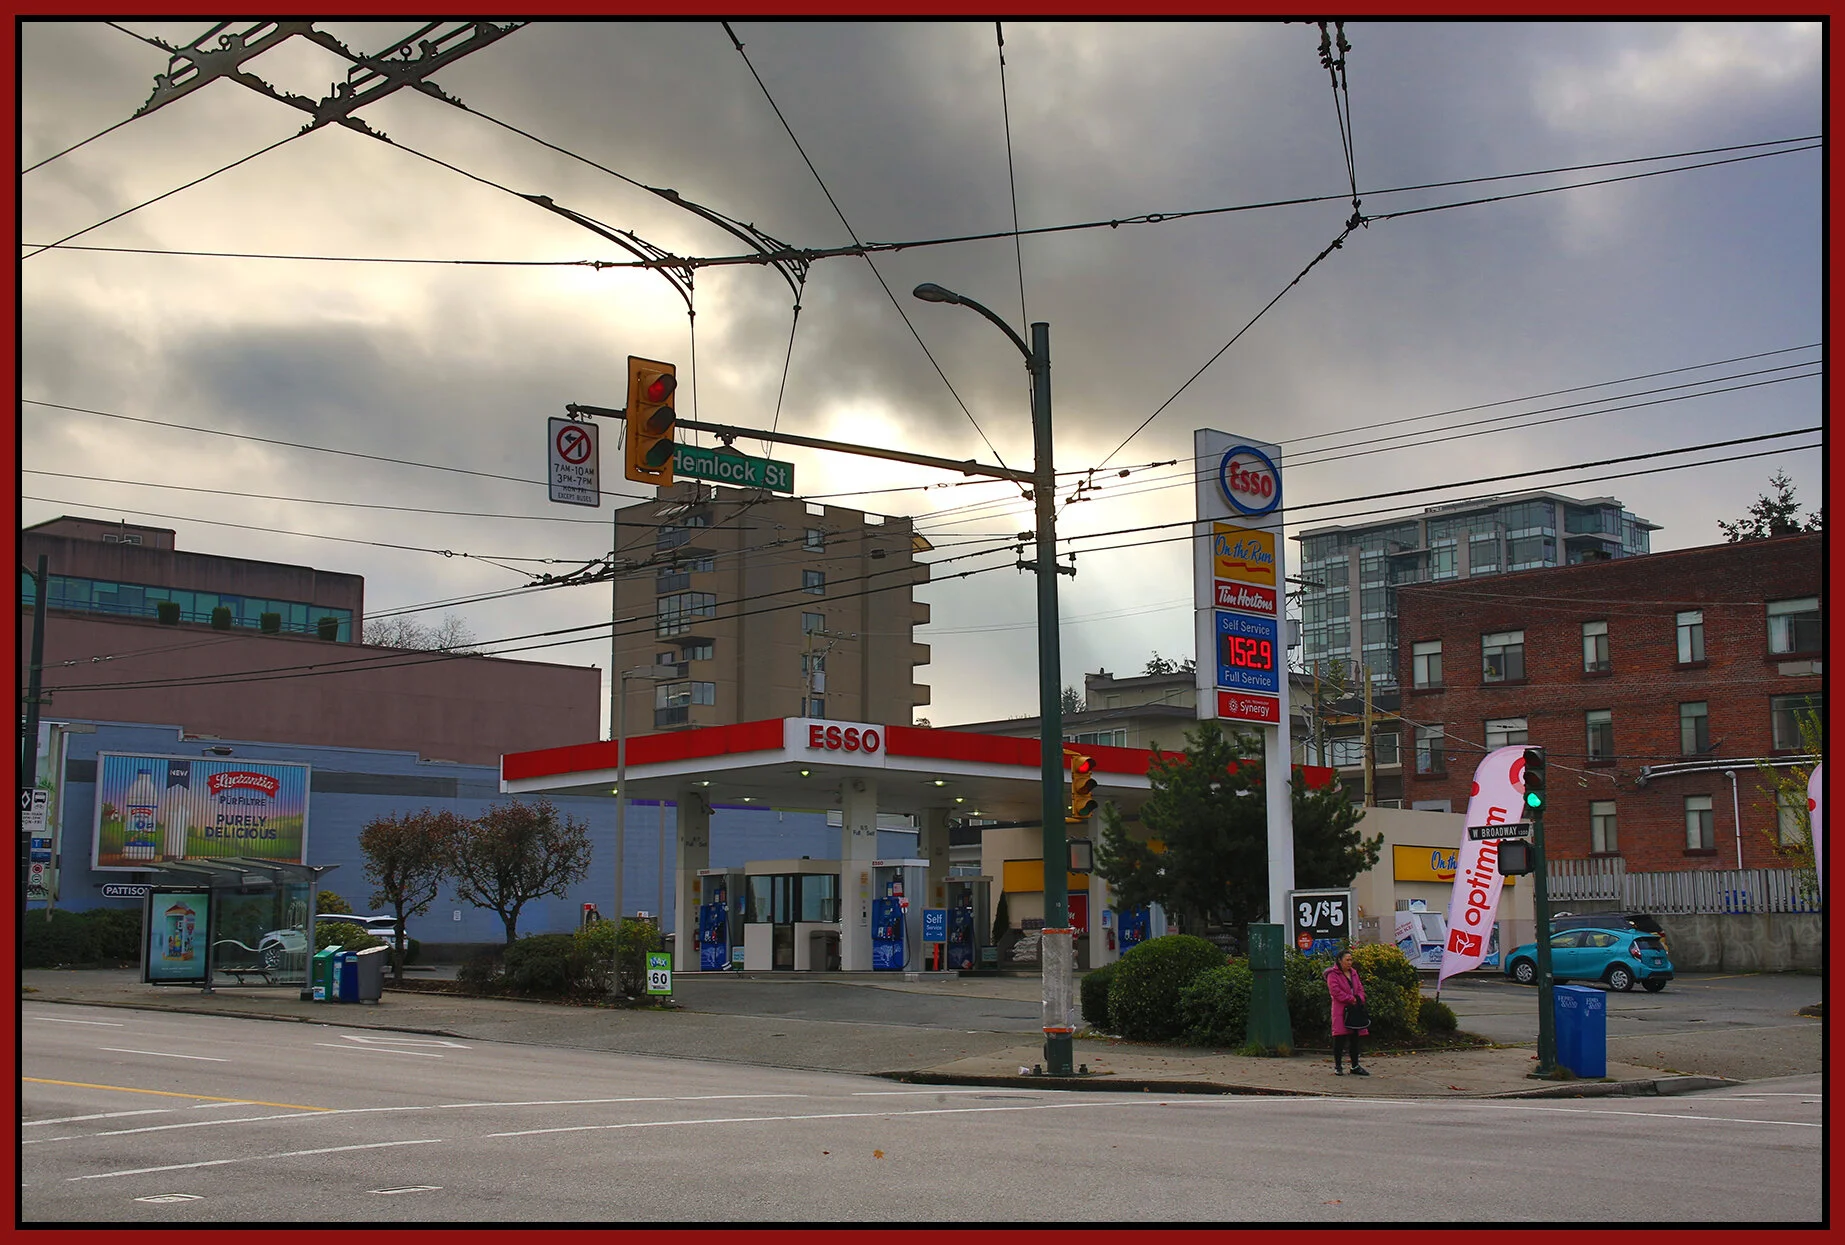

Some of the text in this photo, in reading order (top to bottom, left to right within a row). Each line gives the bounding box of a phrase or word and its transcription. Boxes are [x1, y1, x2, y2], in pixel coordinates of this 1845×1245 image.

[673, 449, 785, 487] Hemlock St
[558, 492, 592, 503] EXCEPT BUSES
[1215, 534, 1274, 564] On the Run
[1218, 585, 1273, 610] Tim Hortons
[1222, 618, 1271, 635] Self Service
[1227, 635, 1272, 670] 152.9
[1225, 670, 1272, 686] Full Service
[1240, 701, 1270, 717] Synergy
[808, 724, 881, 754] ESSO
[170, 769, 189, 777] NEW
[213, 773, 275, 790] Lactantia
[216, 814, 268, 827] PURELY
[205, 826, 277, 840] DELICIOUS
[1472, 828, 1479, 838] W
[1481, 826, 1518, 838] BROADWAY
[1431, 850, 1458, 871] On th
[106, 886, 148, 895] PATTISO
[926, 914, 943, 924] Self
[1299, 900, 1344, 928] 3/$5
